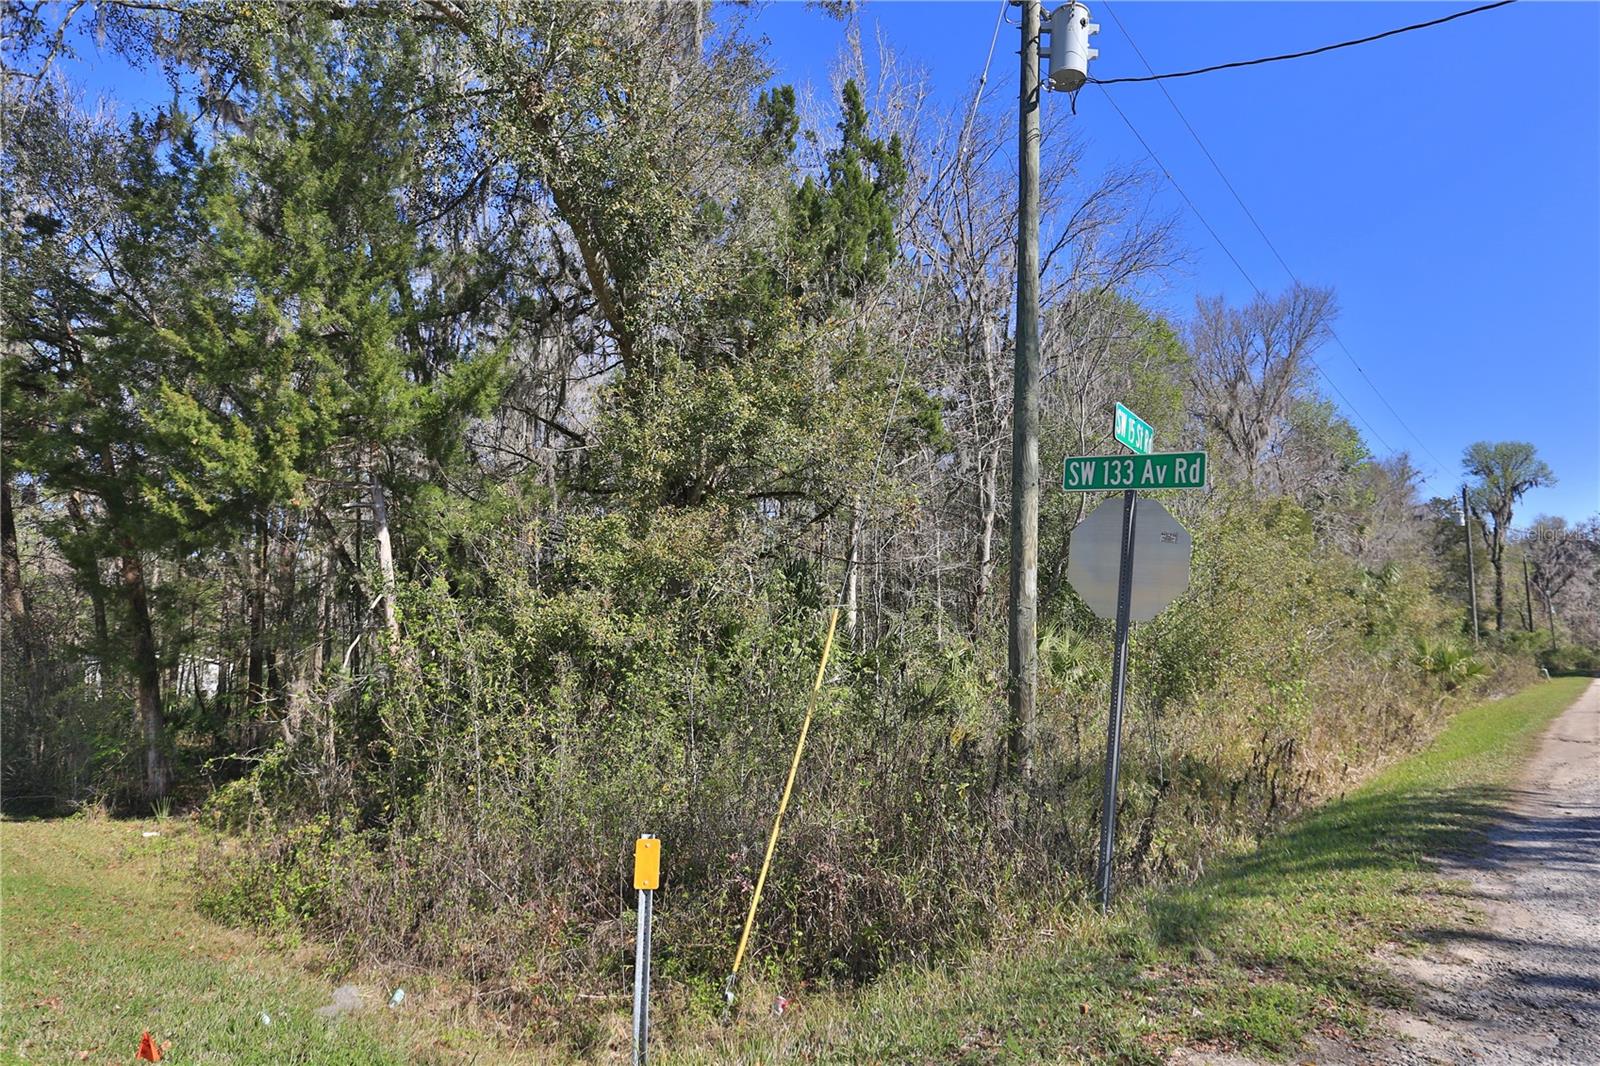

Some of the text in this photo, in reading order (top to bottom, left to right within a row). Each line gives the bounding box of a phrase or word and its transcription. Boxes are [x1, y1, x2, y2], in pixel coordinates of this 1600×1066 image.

[1115, 409, 1127, 438] SW
[1068, 457, 1201, 486] SW 133 Av Rd
